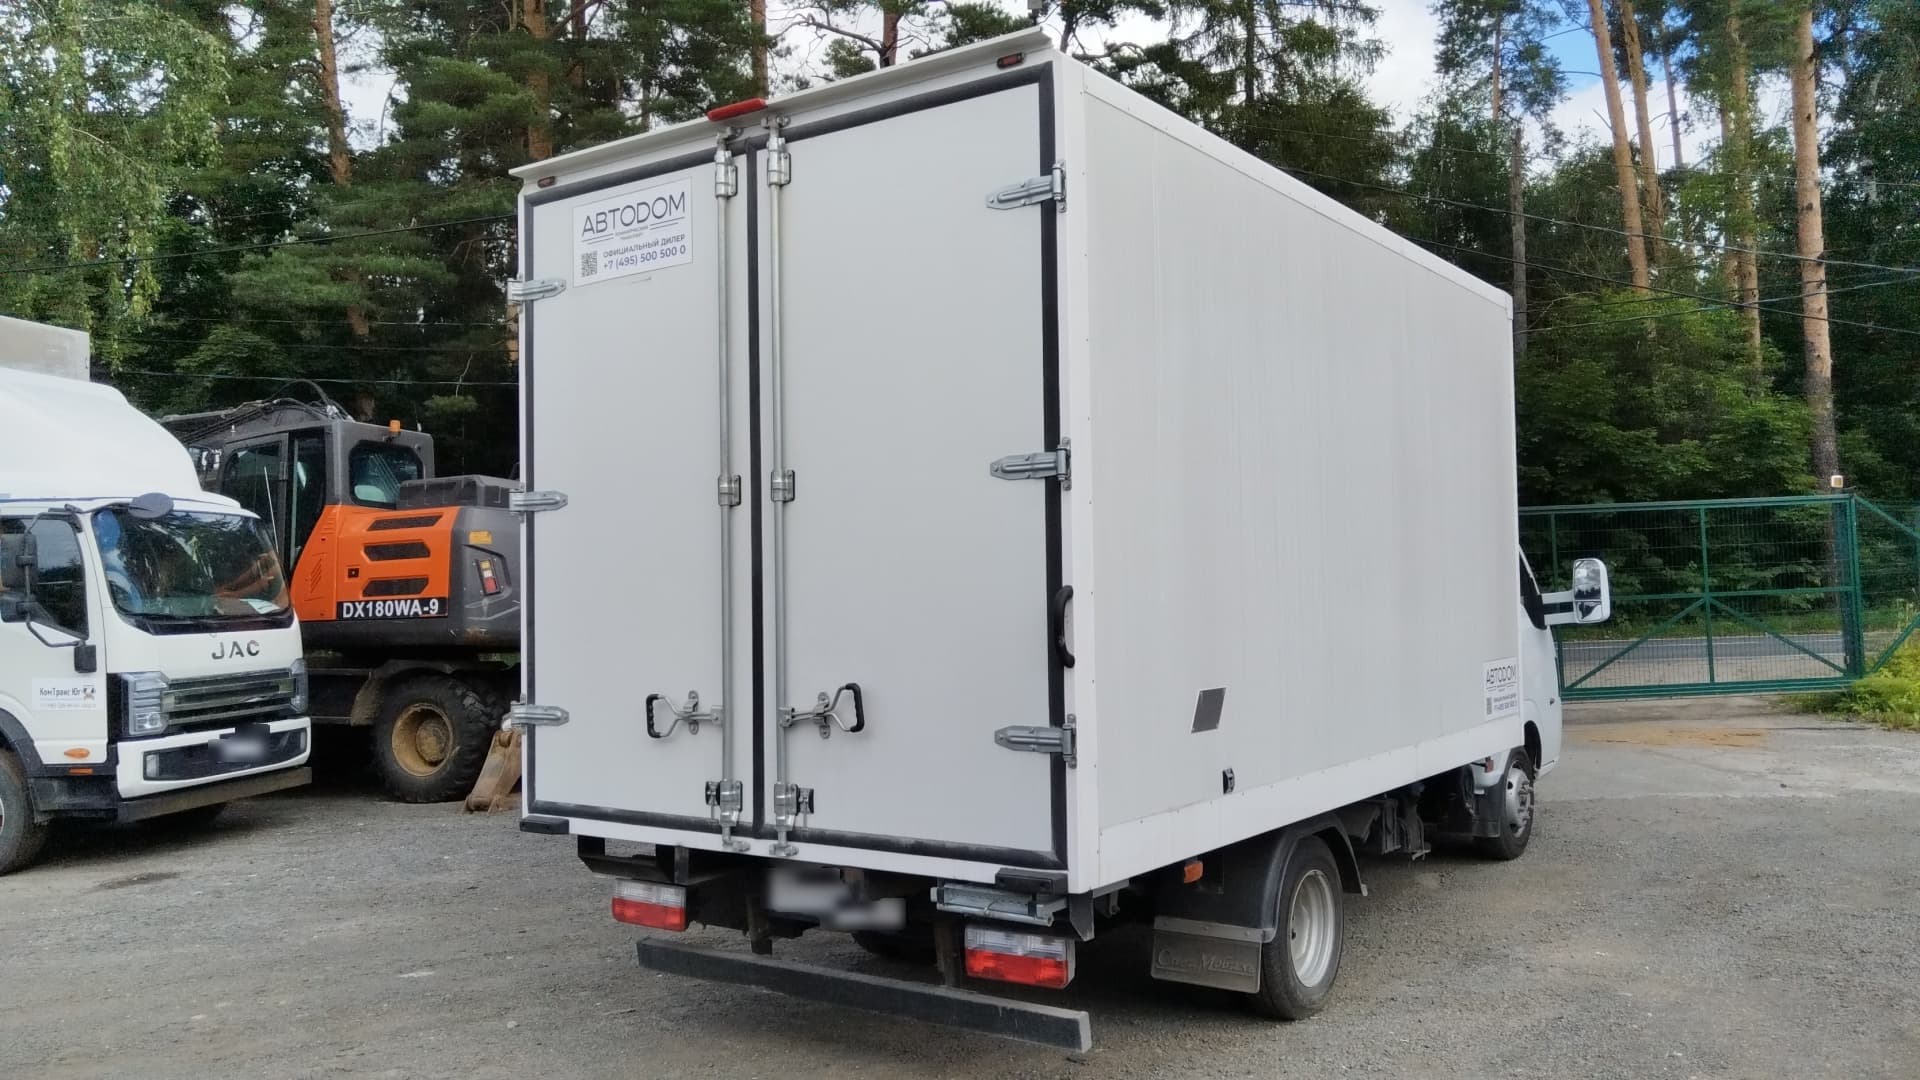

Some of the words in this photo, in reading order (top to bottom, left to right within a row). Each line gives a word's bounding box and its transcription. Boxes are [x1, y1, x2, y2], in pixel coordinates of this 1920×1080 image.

[603, 239, 659, 258] ОФИЦИАЛЬНЫЙ
[660, 234, 685, 246] ДИЛЕР
[603, 259, 614, 270] +7
[616, 255, 638, 270] (495)
[640, 250, 658, 263] 500
[660, 247, 678, 259] 500
[680, 244, 686, 255] 0
[342, 598, 439, 619] DX180WA-9
[211, 640, 260, 660] JAC
